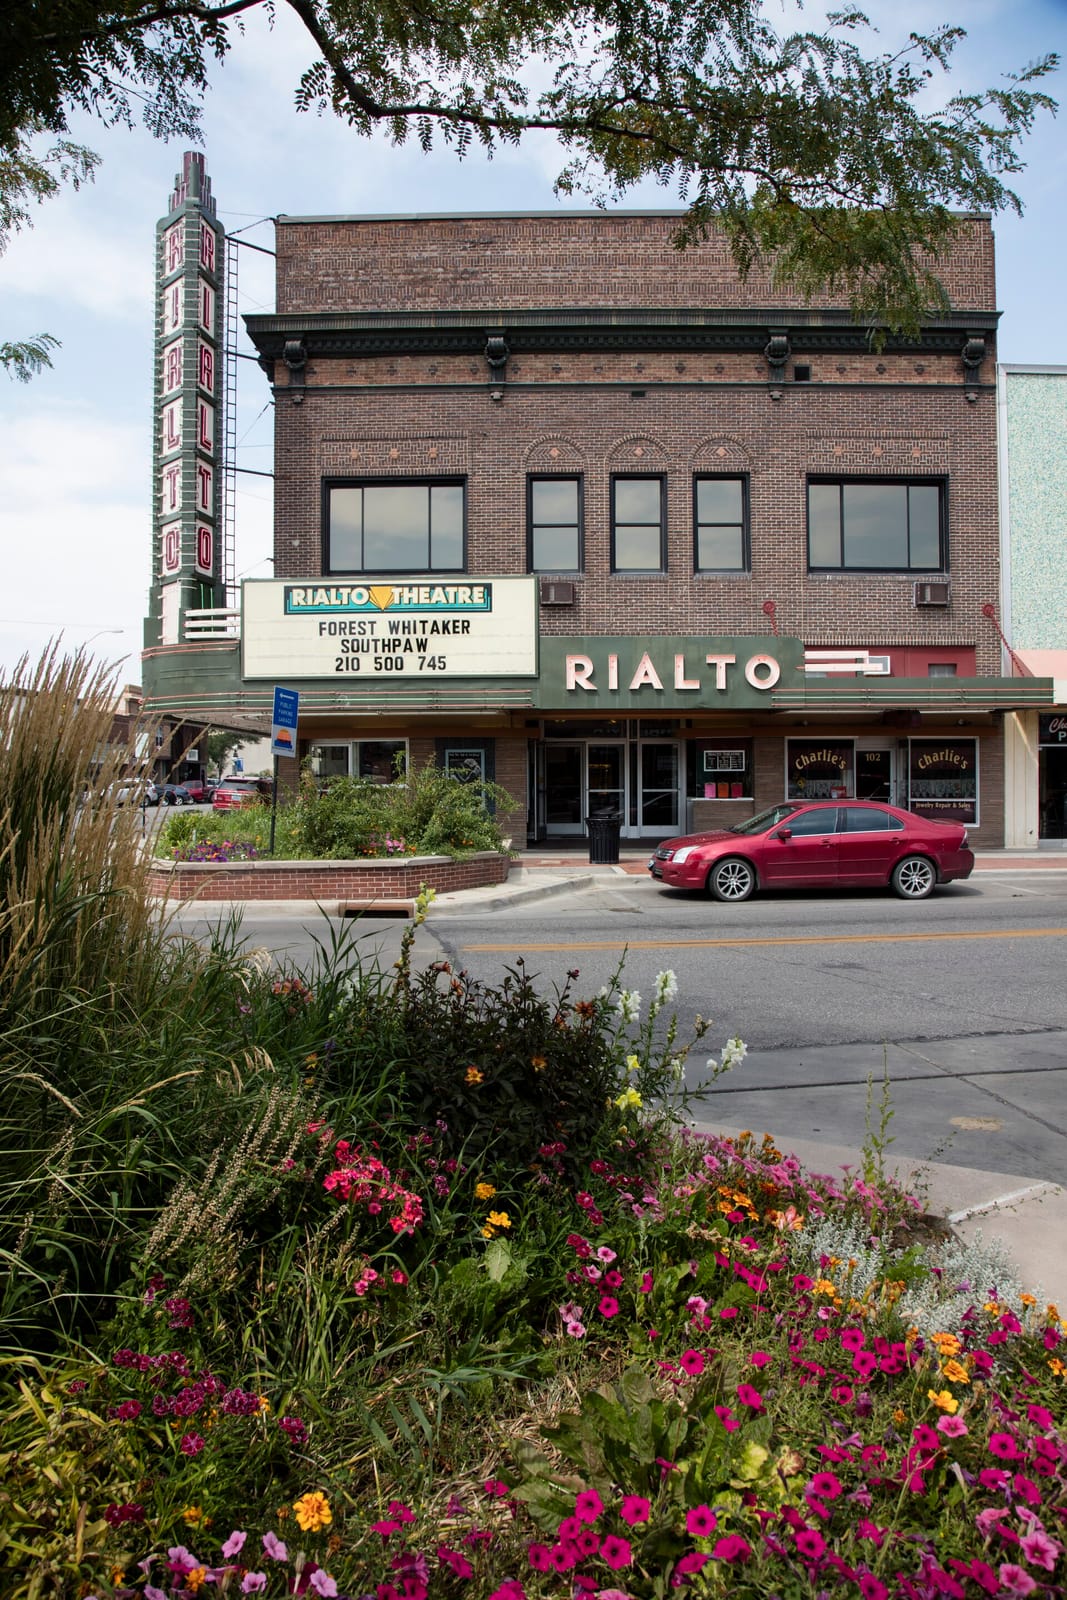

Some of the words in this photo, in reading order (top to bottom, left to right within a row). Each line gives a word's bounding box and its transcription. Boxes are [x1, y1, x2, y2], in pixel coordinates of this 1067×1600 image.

[165, 228, 184, 572] RIALTO
[199, 224, 215, 573] RIALTO
[291, 586, 371, 606] RIALTO
[391, 585, 485, 605] THEATRE
[319, 620, 377, 636] FOREST
[388, 619, 471, 635] WHITAKER
[341, 638, 428, 653] SOUTHPAW
[335, 656, 360, 672] 210
[374, 656, 404, 671] 500
[418, 655, 447, 671] 745
[565, 651, 781, 691] RIALTO
[795, 749, 847, 770] Charlie's
[864, 752, 881, 762] 102
[918, 749, 968, 770] Charlie's
[935, 802, 951, 810] Repair
